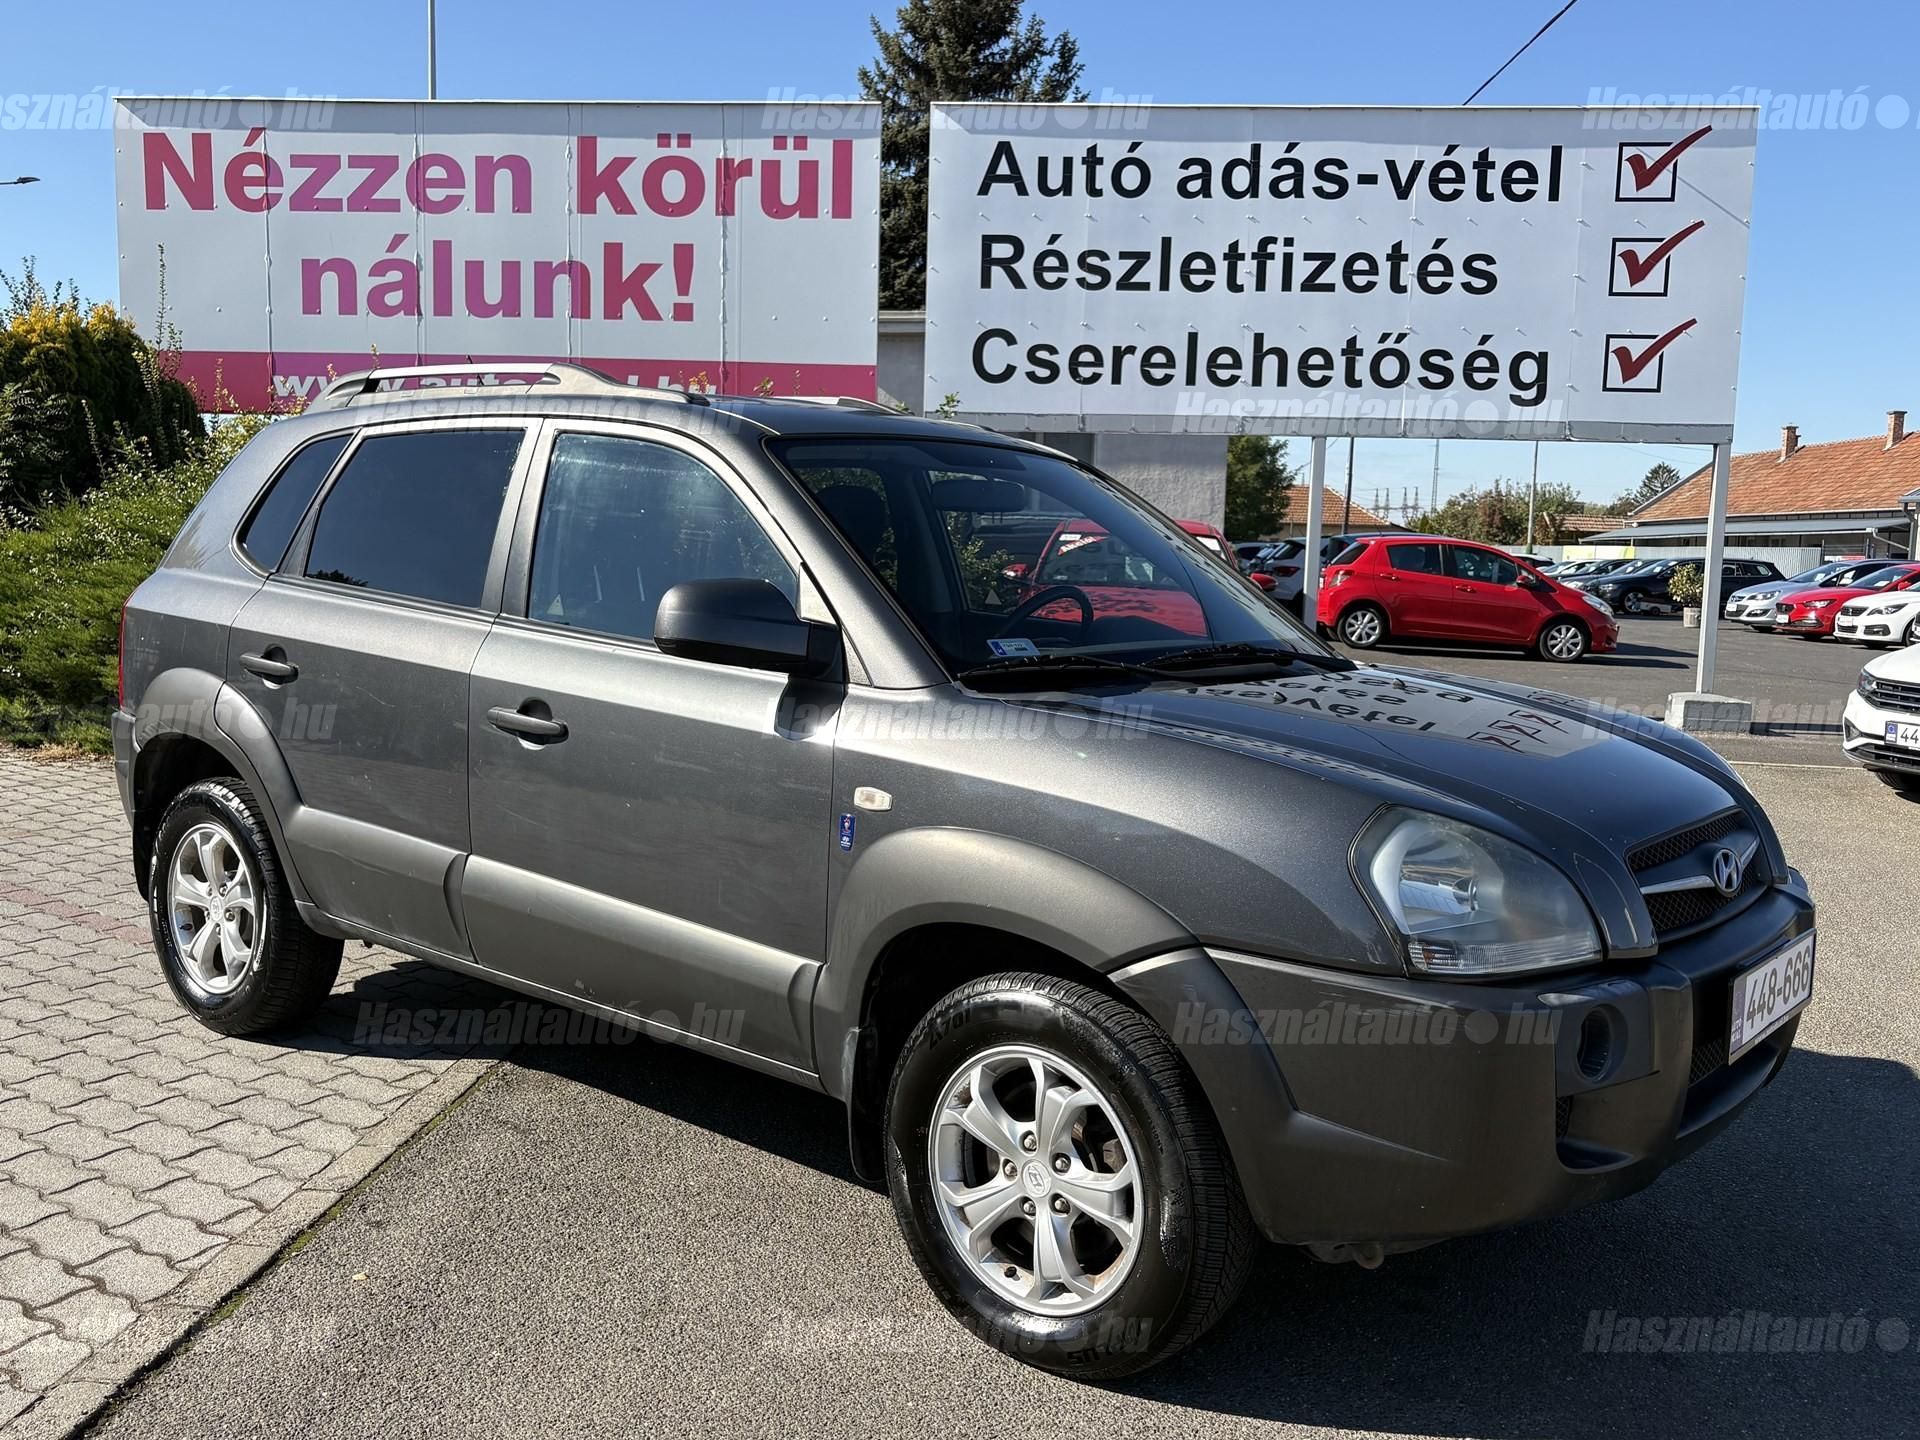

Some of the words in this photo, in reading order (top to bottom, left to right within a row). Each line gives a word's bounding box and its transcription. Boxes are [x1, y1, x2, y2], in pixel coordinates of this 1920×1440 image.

[143, 127, 531, 214] Nézzen
[577, 134, 853, 220] körül
[976, 139, 1152, 200] Autó
[1176, 142, 1563, 204] adás-vétel
[302, 235, 694, 322] nálunk!
[980, 233, 1498, 297] Részletfizetés
[972, 327, 1550, 408] Cserelehetőség
[1746, 945, 1811, 1029] 448-666
